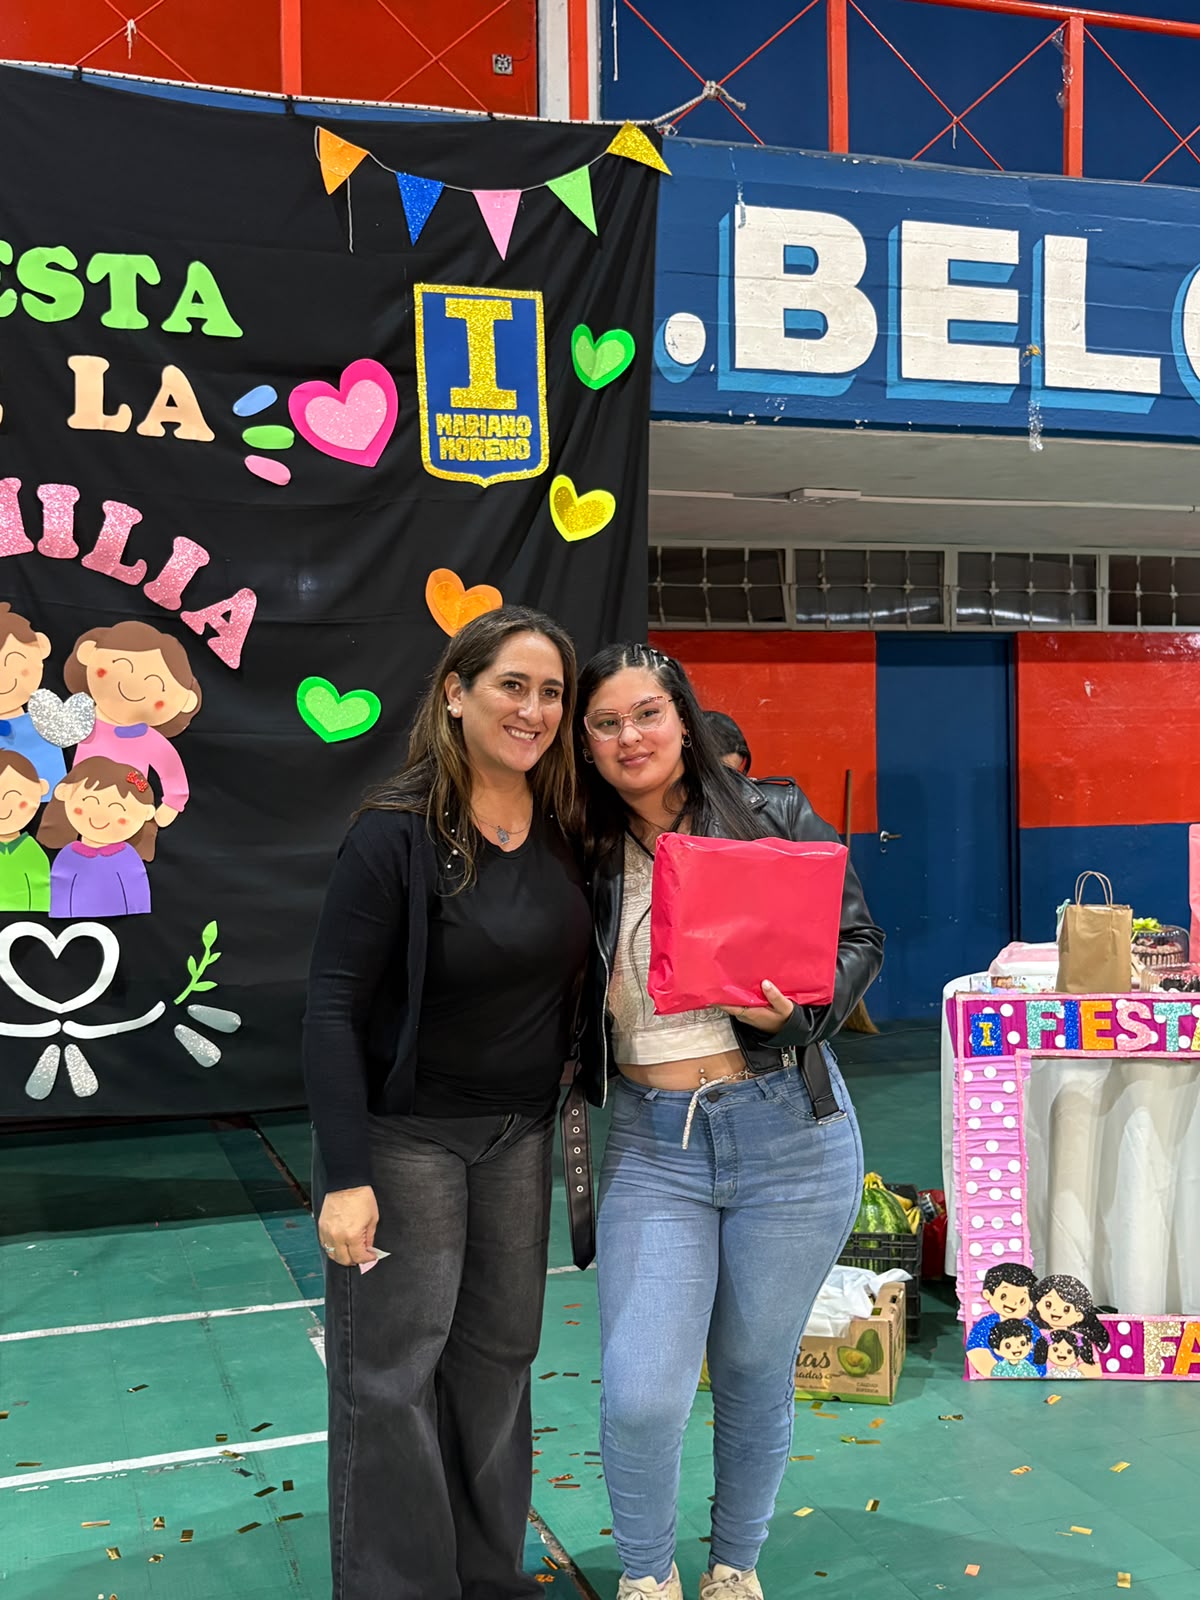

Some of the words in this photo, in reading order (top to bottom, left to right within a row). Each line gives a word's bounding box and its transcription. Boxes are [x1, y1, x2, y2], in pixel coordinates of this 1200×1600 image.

[664, 204, 1200, 396] .BEL
[445, 297, 518, 411] I
[67, 355, 215, 442] LA
[436, 413, 532, 438] MARIANO
[439, 437, 531, 462] MORENO
[1026, 1000, 1200, 1052] FIEST
